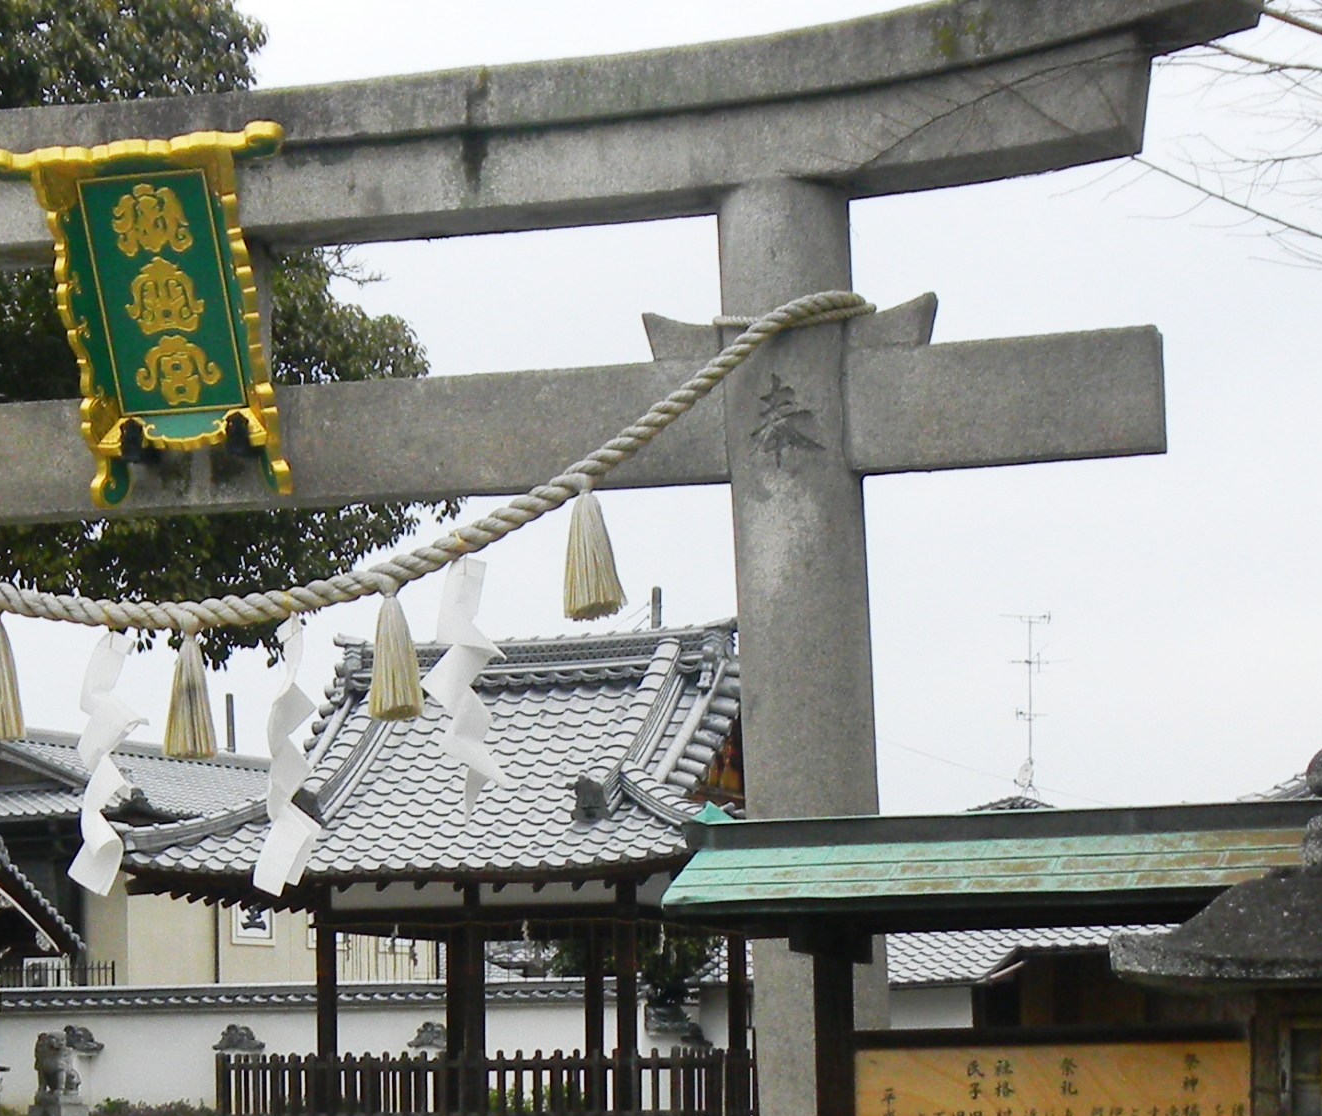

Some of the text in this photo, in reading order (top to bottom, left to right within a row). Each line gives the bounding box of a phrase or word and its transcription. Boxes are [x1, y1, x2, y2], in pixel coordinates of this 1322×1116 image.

[994, 1059, 1015, 1098] 社格
[1061, 1057, 1078, 1096] 祭礼
[1182, 1053, 1201, 1092] 祭神
